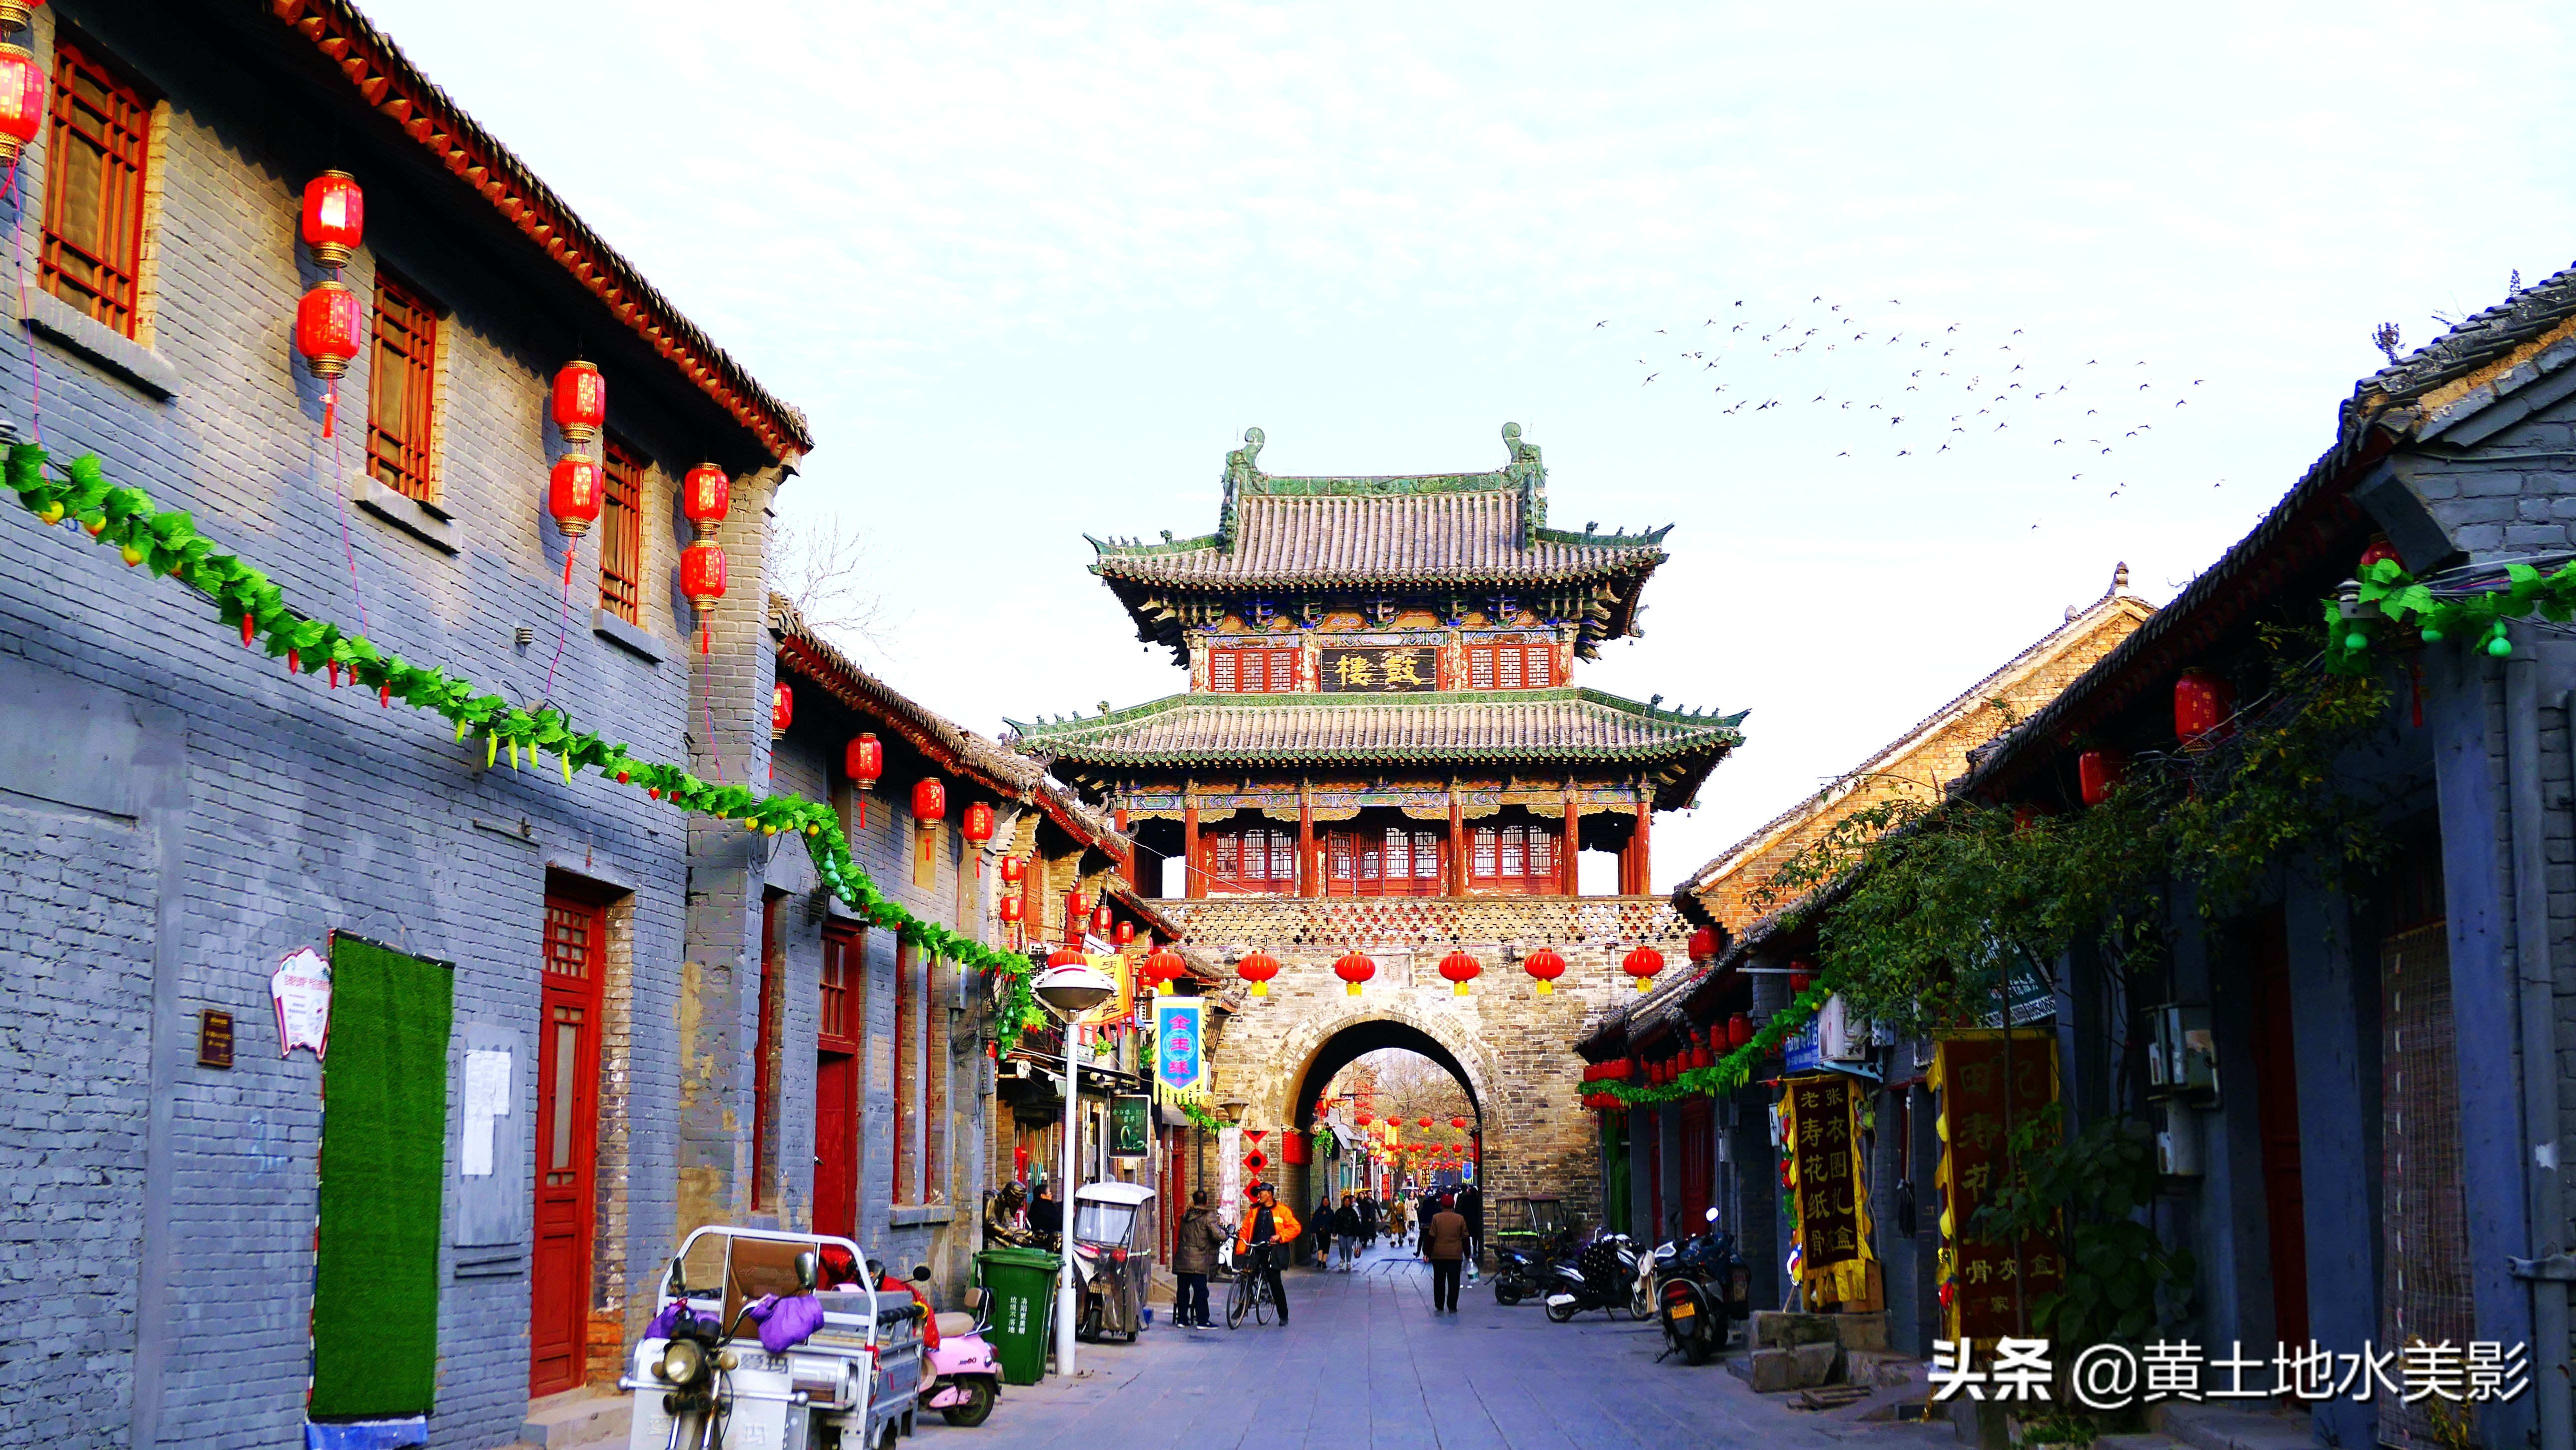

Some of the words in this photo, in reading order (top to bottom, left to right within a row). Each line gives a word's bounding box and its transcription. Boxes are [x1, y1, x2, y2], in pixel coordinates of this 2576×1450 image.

[1168, 1014, 1191, 1074] 金玉缘
[1008, 1296, 1017, 1334] 垃圾不落地
[1018, 1297, 1027, 1335] 洛阳更美丽
